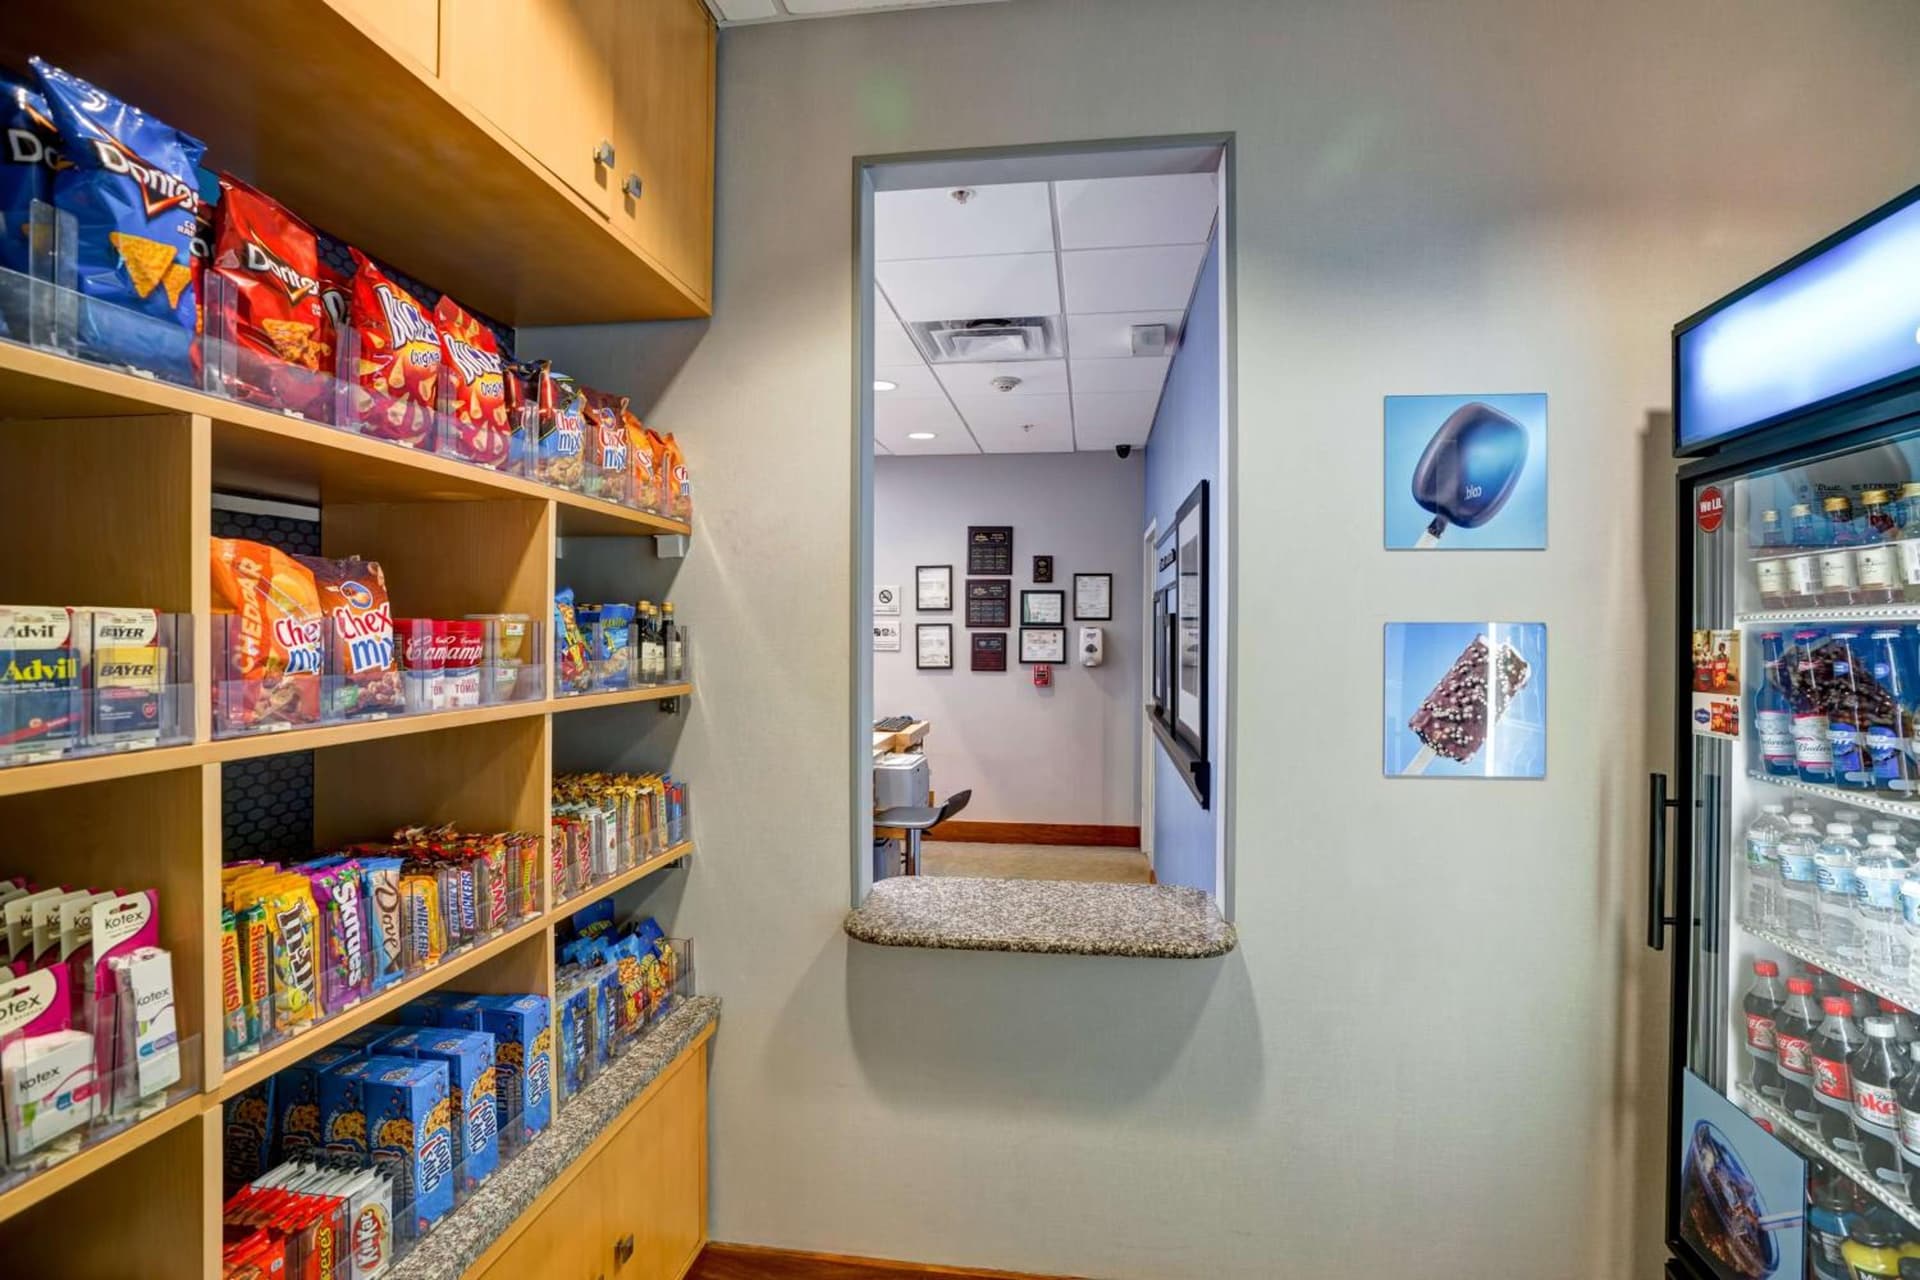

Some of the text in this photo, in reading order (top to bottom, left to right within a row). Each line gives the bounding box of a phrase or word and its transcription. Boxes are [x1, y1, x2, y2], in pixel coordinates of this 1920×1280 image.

[335, 604, 393, 640] Chex
[4, 625, 55, 638] Advil
[100, 626, 144, 639] BAYER
[0, 657, 77, 681] Advil
[100, 664, 154, 676] BAYER
[462, 872, 473, 928] SNICKERS
